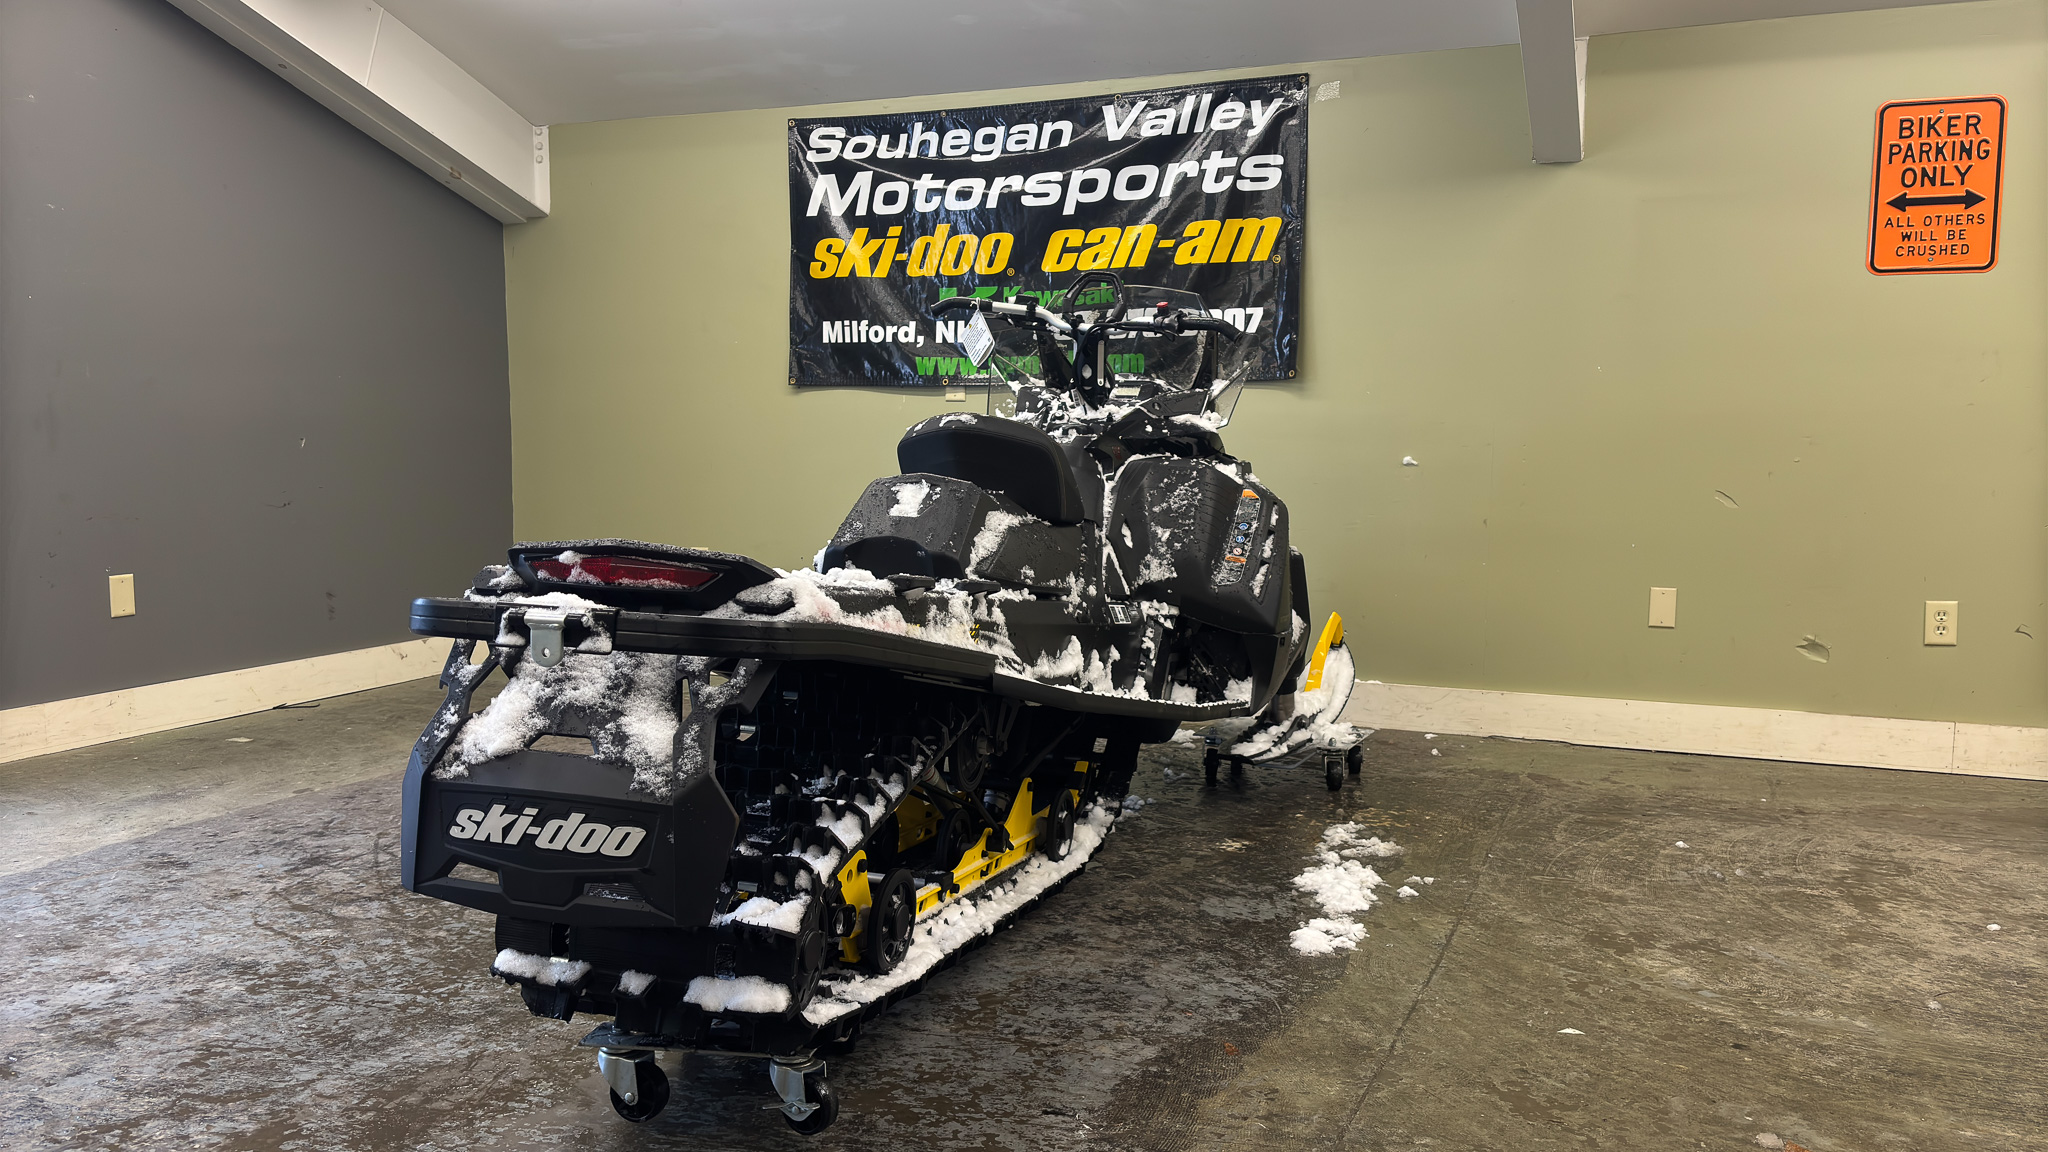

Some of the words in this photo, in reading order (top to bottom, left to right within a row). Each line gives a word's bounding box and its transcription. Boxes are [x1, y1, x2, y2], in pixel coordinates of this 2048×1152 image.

[805, 120, 1073, 163] Souhegan
[1101, 93, 1286, 146] Valley
[1898, 114, 1982, 140] BIKER
[1888, 138, 1991, 165] PARKING
[804, 151, 1284, 218] Motorsports
[1900, 164, 1975, 189] ONLY
[1884, 216, 1915, 229] ALL
[1923, 213, 1986, 227] OTHERS
[809, 223, 1015, 279] ski-doo
[1041, 216, 1283, 273] can-am
[1901, 230, 1939, 242] WILL
[1947, 228, 1967, 241] BE
[1895, 243, 1970, 257] CRUSHED
[822, 319, 925, 348] Milford,
[449, 804, 647, 857] ski-doo
